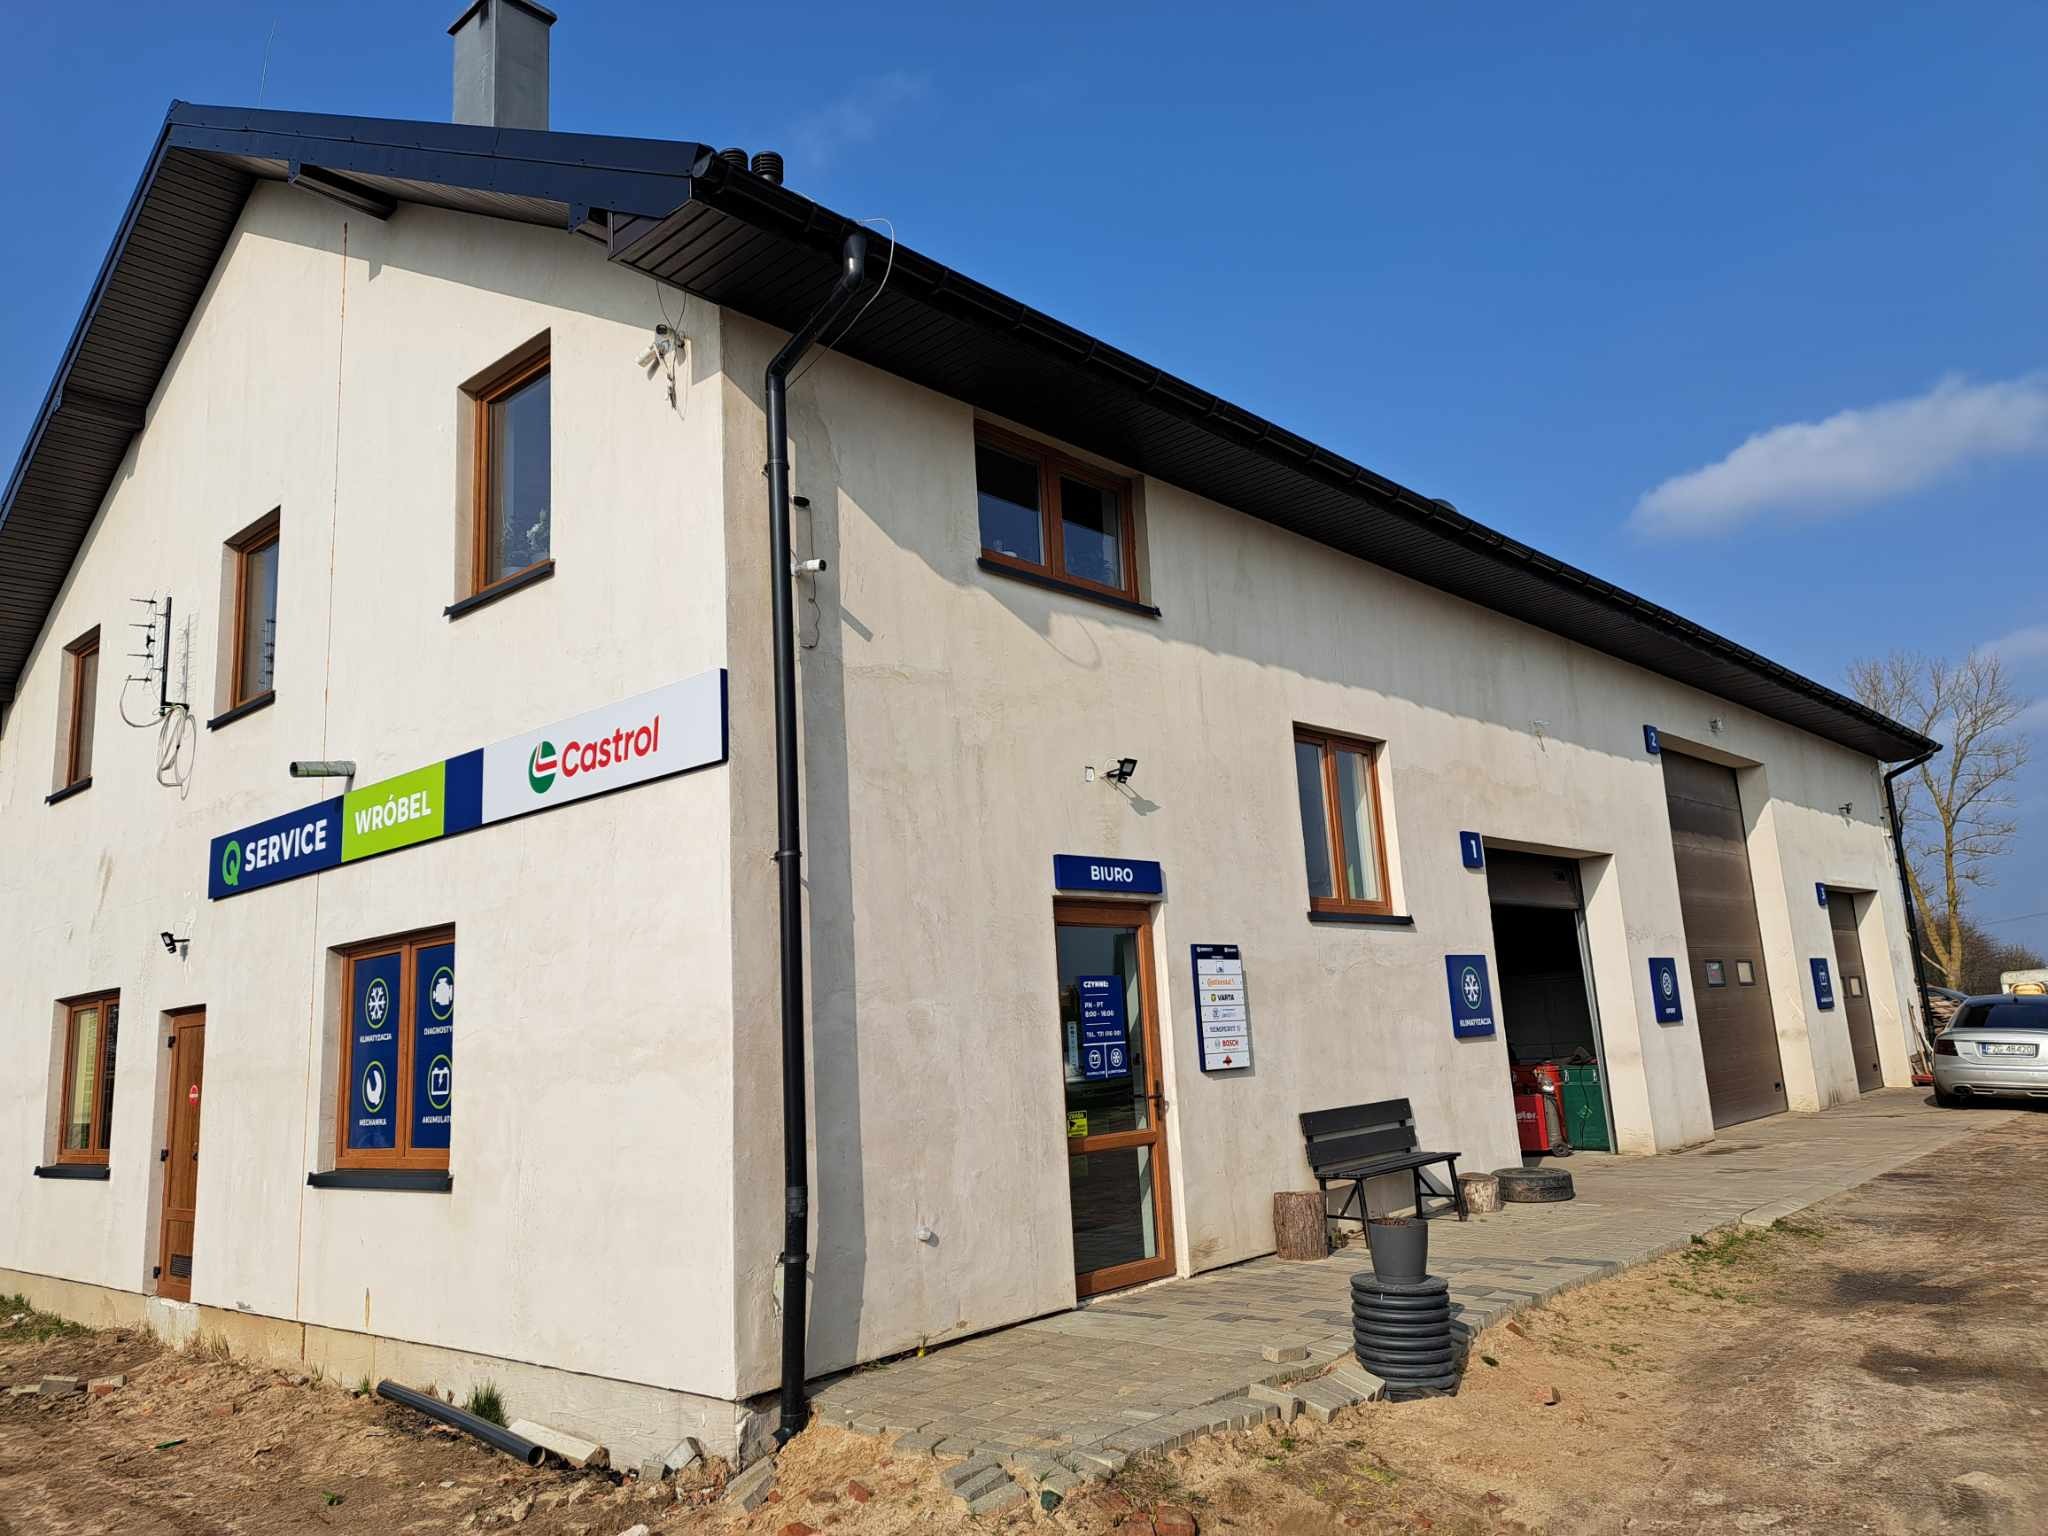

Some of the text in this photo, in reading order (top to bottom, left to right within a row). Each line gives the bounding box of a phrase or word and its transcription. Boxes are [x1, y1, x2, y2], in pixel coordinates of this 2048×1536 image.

[561, 714, 660, 778] Castrol
[1650, 732, 1657, 747] 2
[354, 790, 432, 835] WRÓBEL
[222, 819, 328, 886] Q SERVICE
[1470, 839, 1478, 859] 1
[1090, 865, 1134, 883] BIURO
[1216, 993, 1235, 1001] VARTA
[424, 1025, 453, 1036] DIAGNOSTY
[1222, 1039, 1239, 1047] BOSCH
[422, 1115, 451, 1124] AKUMULAT
